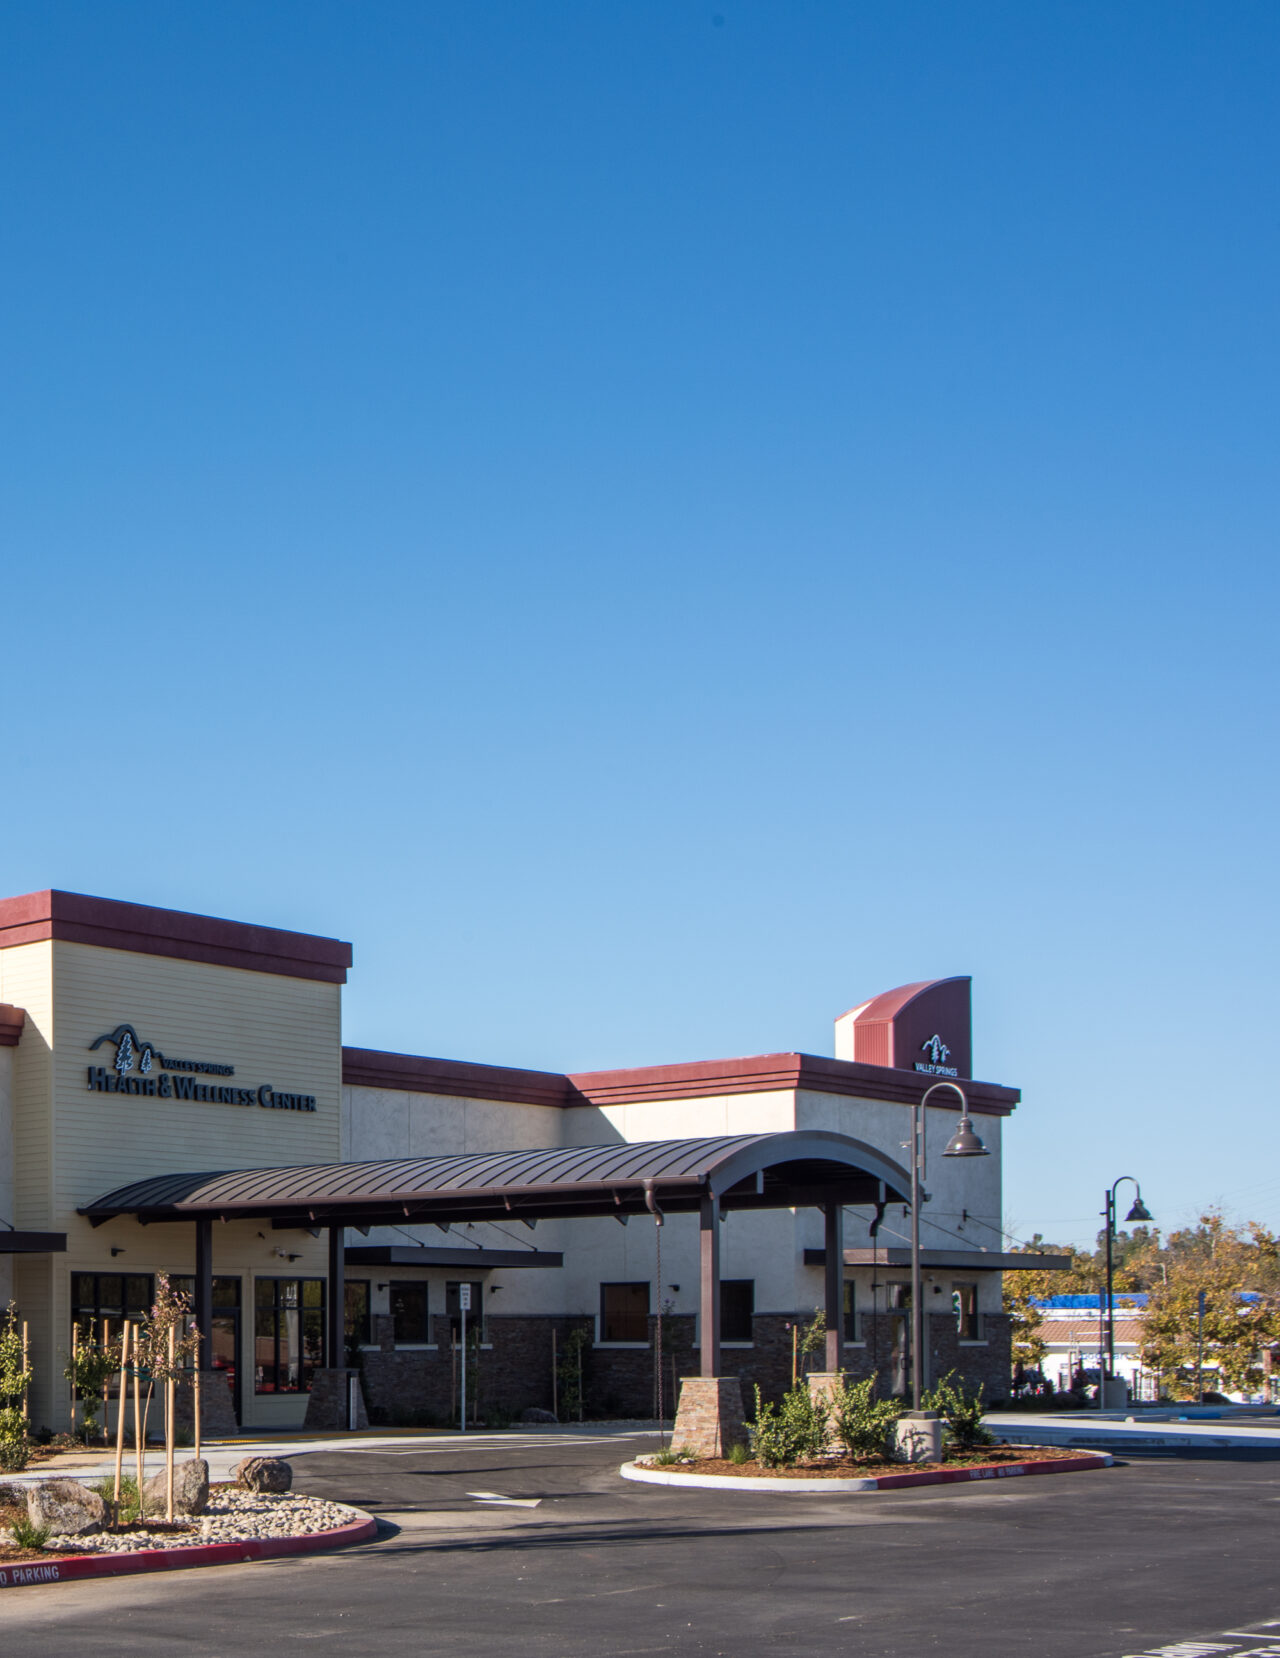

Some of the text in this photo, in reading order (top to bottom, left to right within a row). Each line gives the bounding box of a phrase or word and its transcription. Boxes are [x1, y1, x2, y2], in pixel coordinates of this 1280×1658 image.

[162, 1058, 234, 1076] VALLEY SPRINGS
[915, 1062, 958, 1077] VALLEY SPRINGS
[88, 1066, 317, 1112] HEALTH & WELLNESS CENTER
[12, 1565, 60, 1583] PARKING
